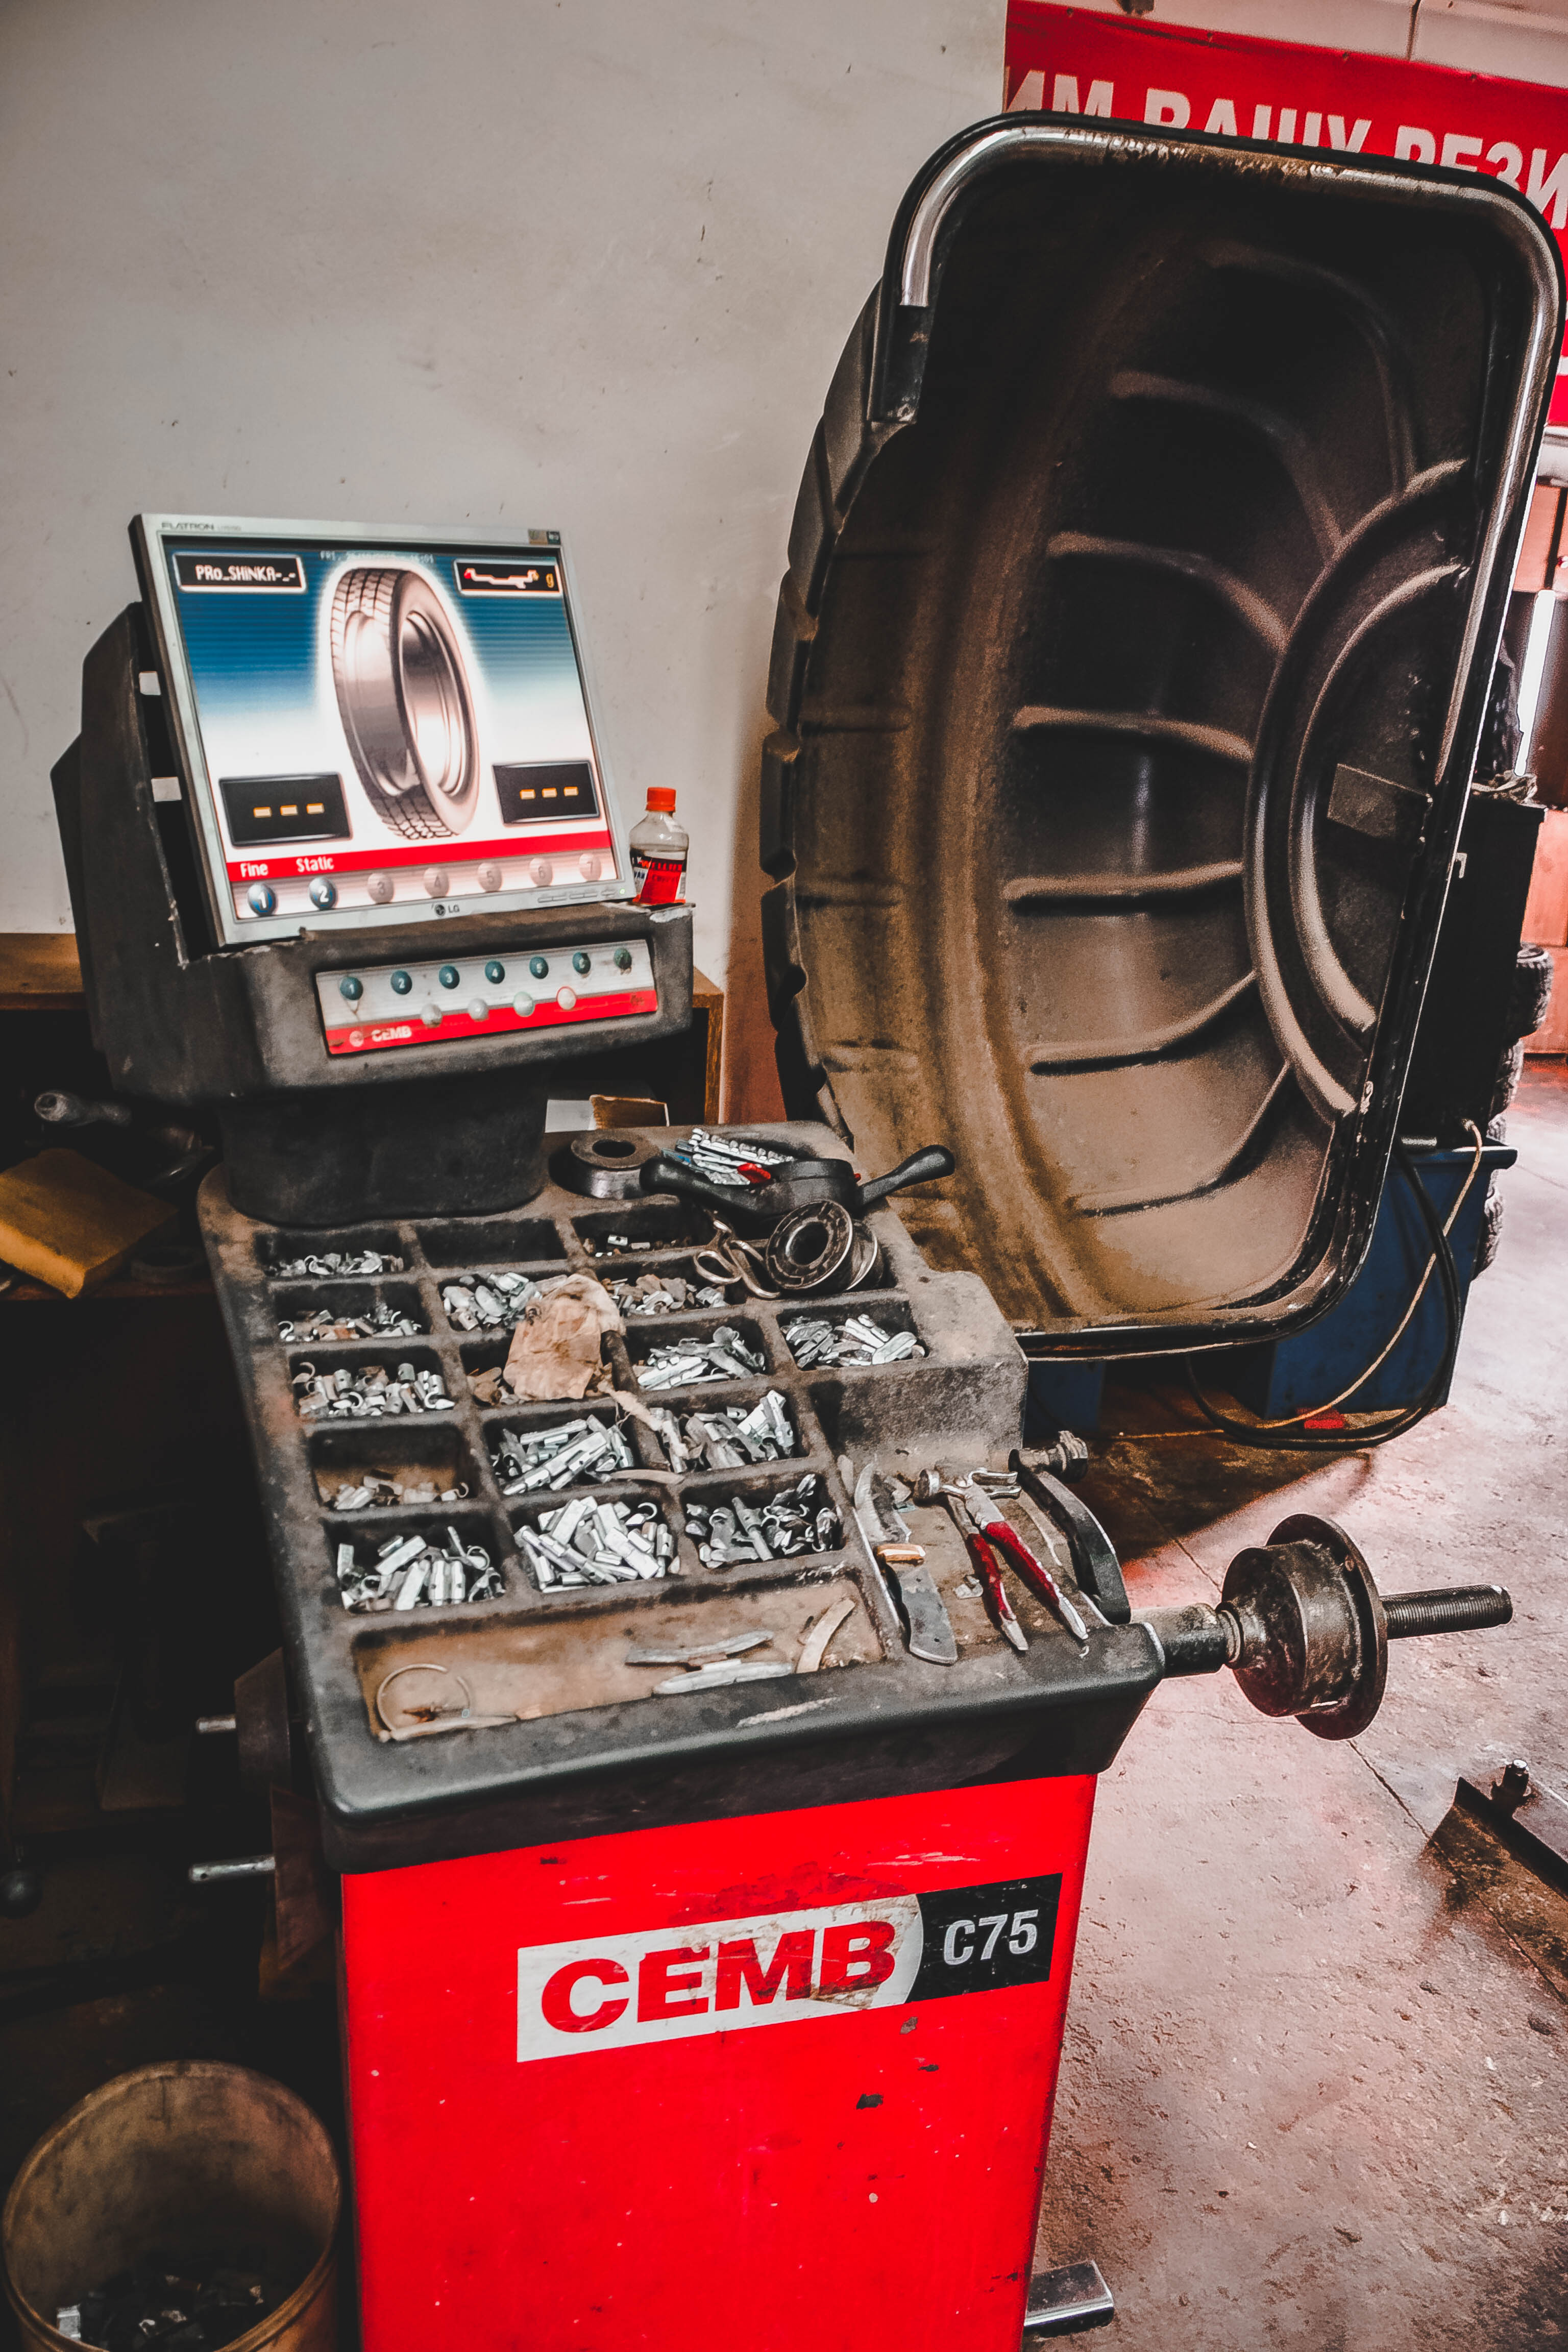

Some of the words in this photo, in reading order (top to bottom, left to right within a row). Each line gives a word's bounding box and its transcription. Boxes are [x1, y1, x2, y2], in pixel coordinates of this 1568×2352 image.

[240, 863, 268, 877] Fine
[296, 856, 334, 872] Static
[259, 892, 267, 909] 1
[318, 886, 329, 902] 2
[486, 871, 495, 884] 5
[538, 866, 546, 878] 6
[448, 904, 460, 913] LG
[349, 985, 354, 994] 1
[398, 978, 405, 989] 2
[445, 973, 453, 983] 3
[372, 1025, 411, 1042] CEMB
[542, 1920, 895, 2033] CEMB
[943, 1910, 1038, 1965] C75
